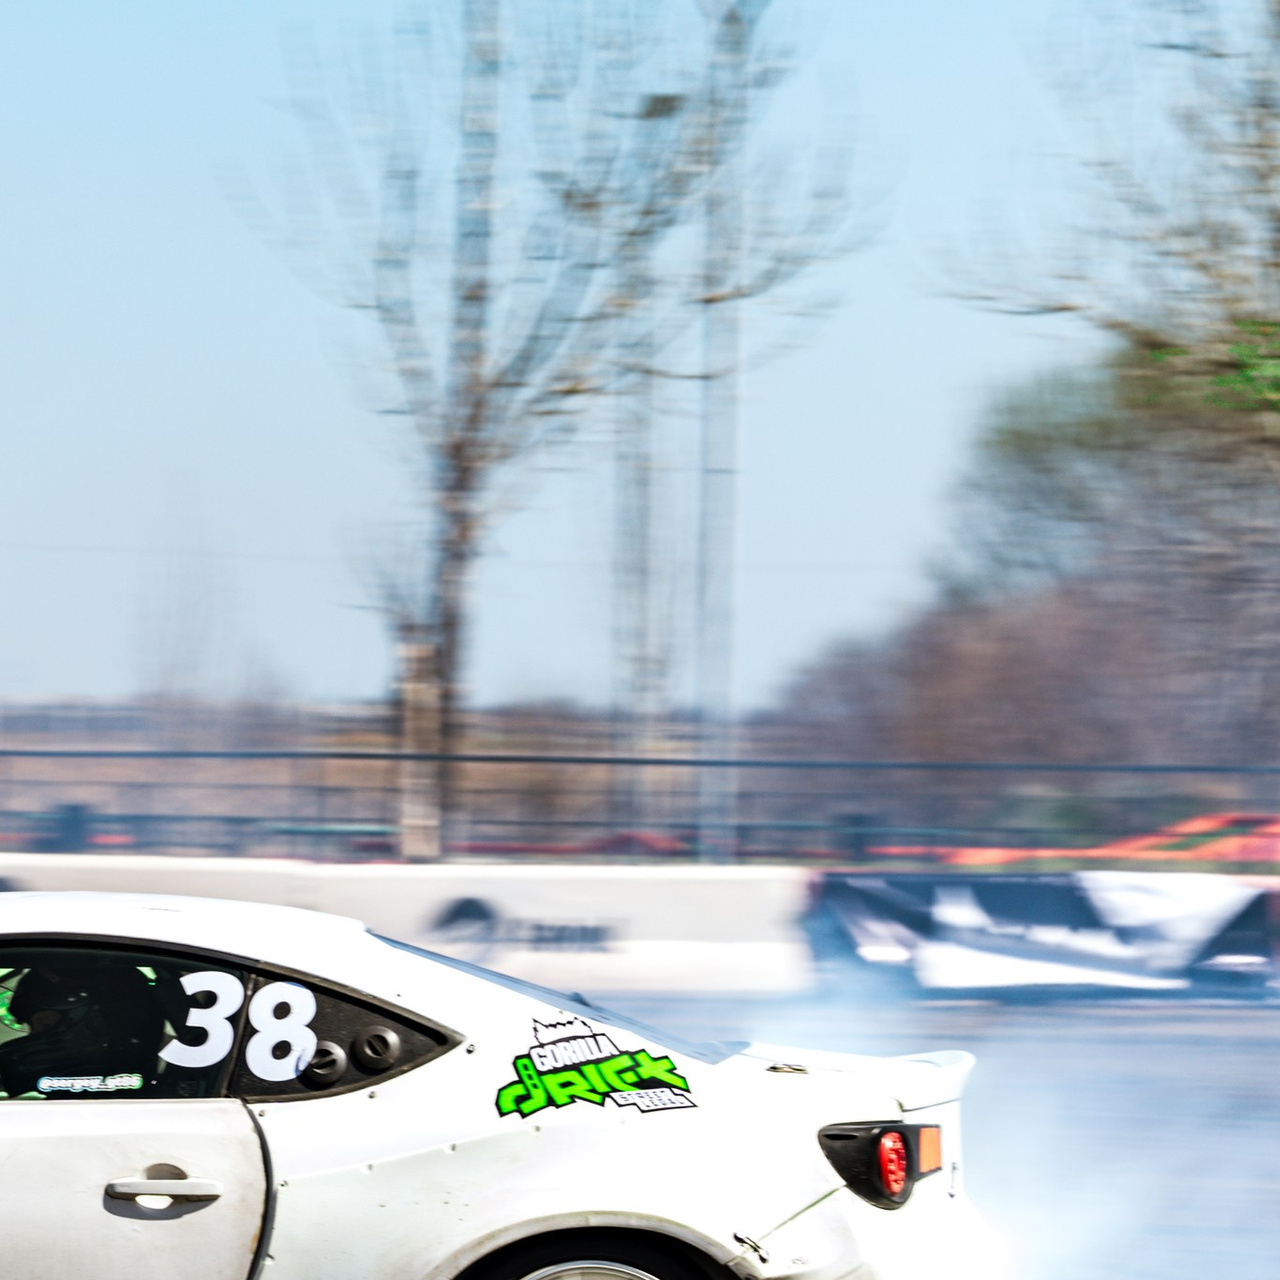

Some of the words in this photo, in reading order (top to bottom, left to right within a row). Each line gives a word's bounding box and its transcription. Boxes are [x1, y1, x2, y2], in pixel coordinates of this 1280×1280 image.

[158, 970, 318, 1082] 38
[530, 1035, 620, 1072] GORILLA
[618, 1090, 667, 1102] STREET
[641, 1098, 686, 1108] LEGAL
